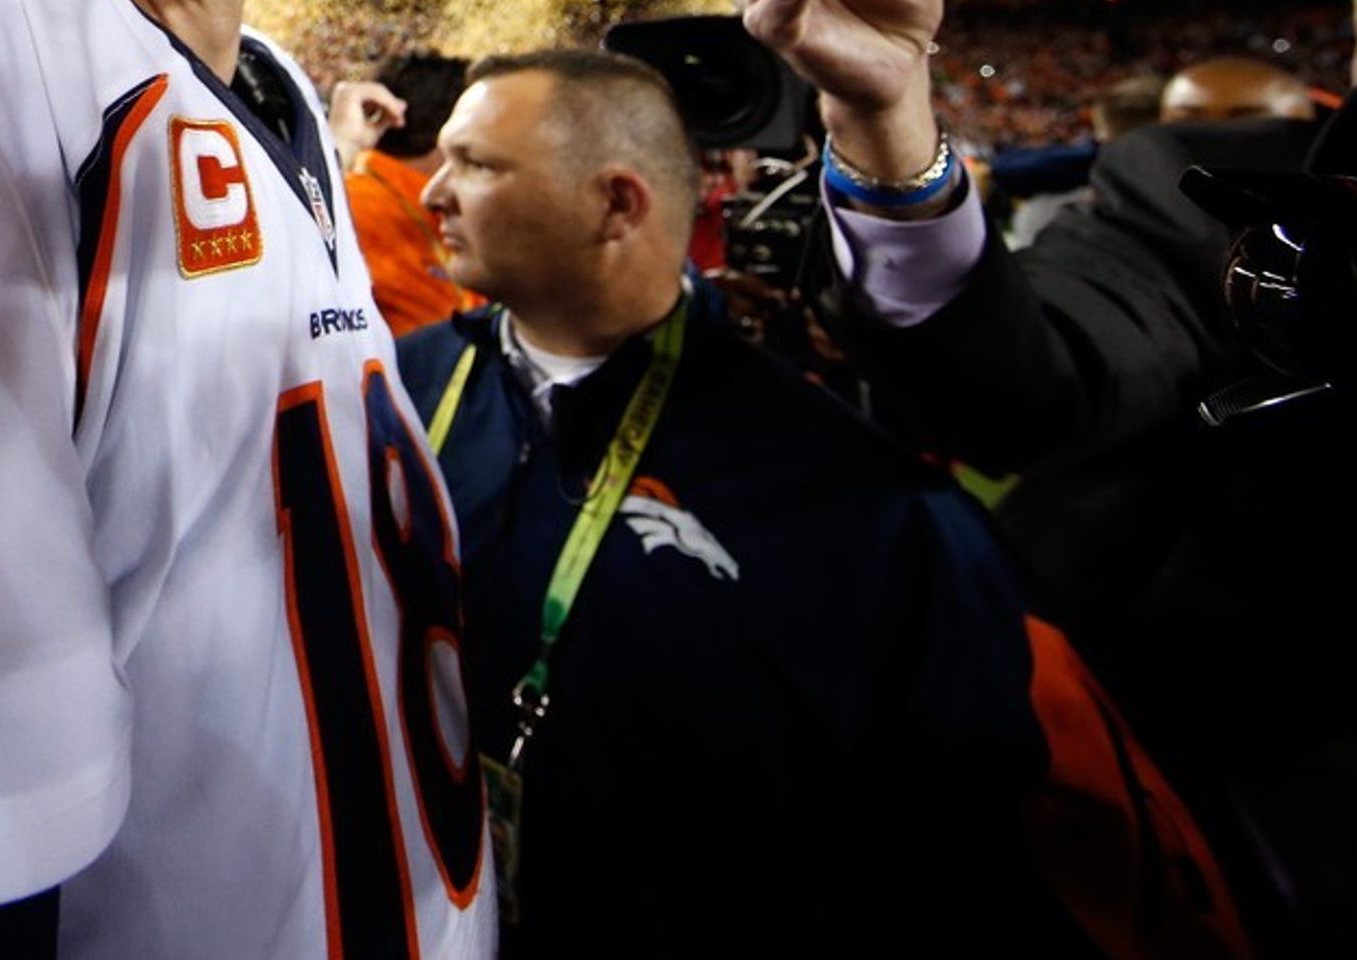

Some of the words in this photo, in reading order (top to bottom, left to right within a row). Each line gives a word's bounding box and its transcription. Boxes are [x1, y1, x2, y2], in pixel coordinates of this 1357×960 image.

[179, 128, 249, 230] C
[310, 308, 367, 339] BRNS
[271, 359, 485, 959] 18
